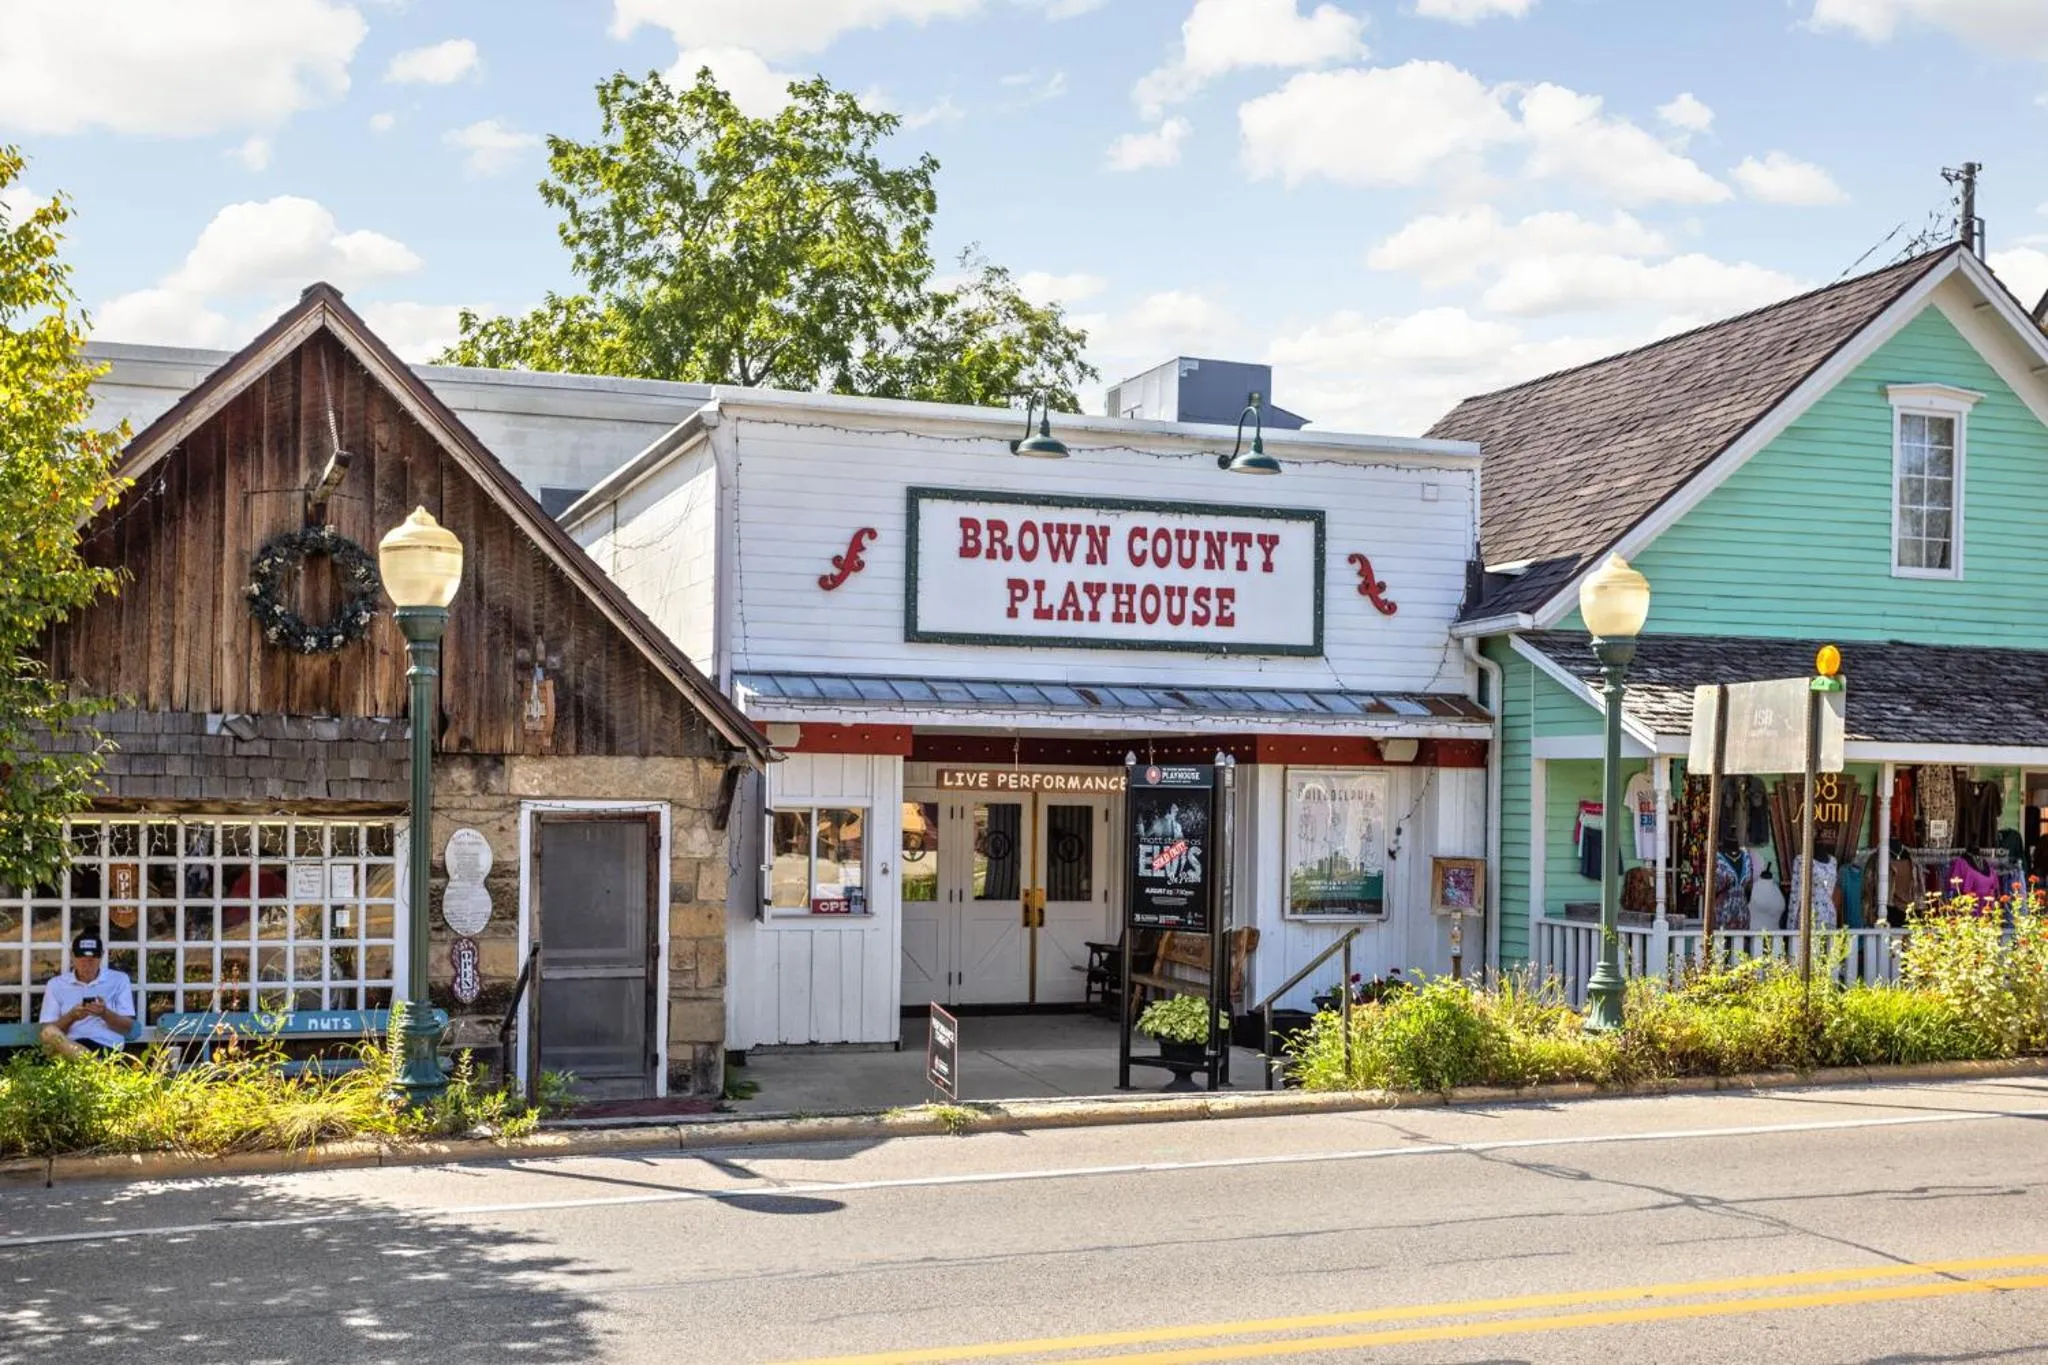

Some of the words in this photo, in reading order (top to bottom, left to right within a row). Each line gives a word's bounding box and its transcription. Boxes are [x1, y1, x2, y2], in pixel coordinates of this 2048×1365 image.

[958, 516, 1110, 566] BROWN
[1127, 526, 1280, 573] COUNTY
[1006, 577, 1236, 627] PLAYHOUSE
[943, 772, 989, 788] LIVE
[1162, 771, 1201, 780] PLAYHOUSE
[1138, 844, 1203, 883] ELVIS
[119, 871, 130, 908] OPE
[819, 901, 849, 913] OPE
[261, 1013, 296, 1030] GT
